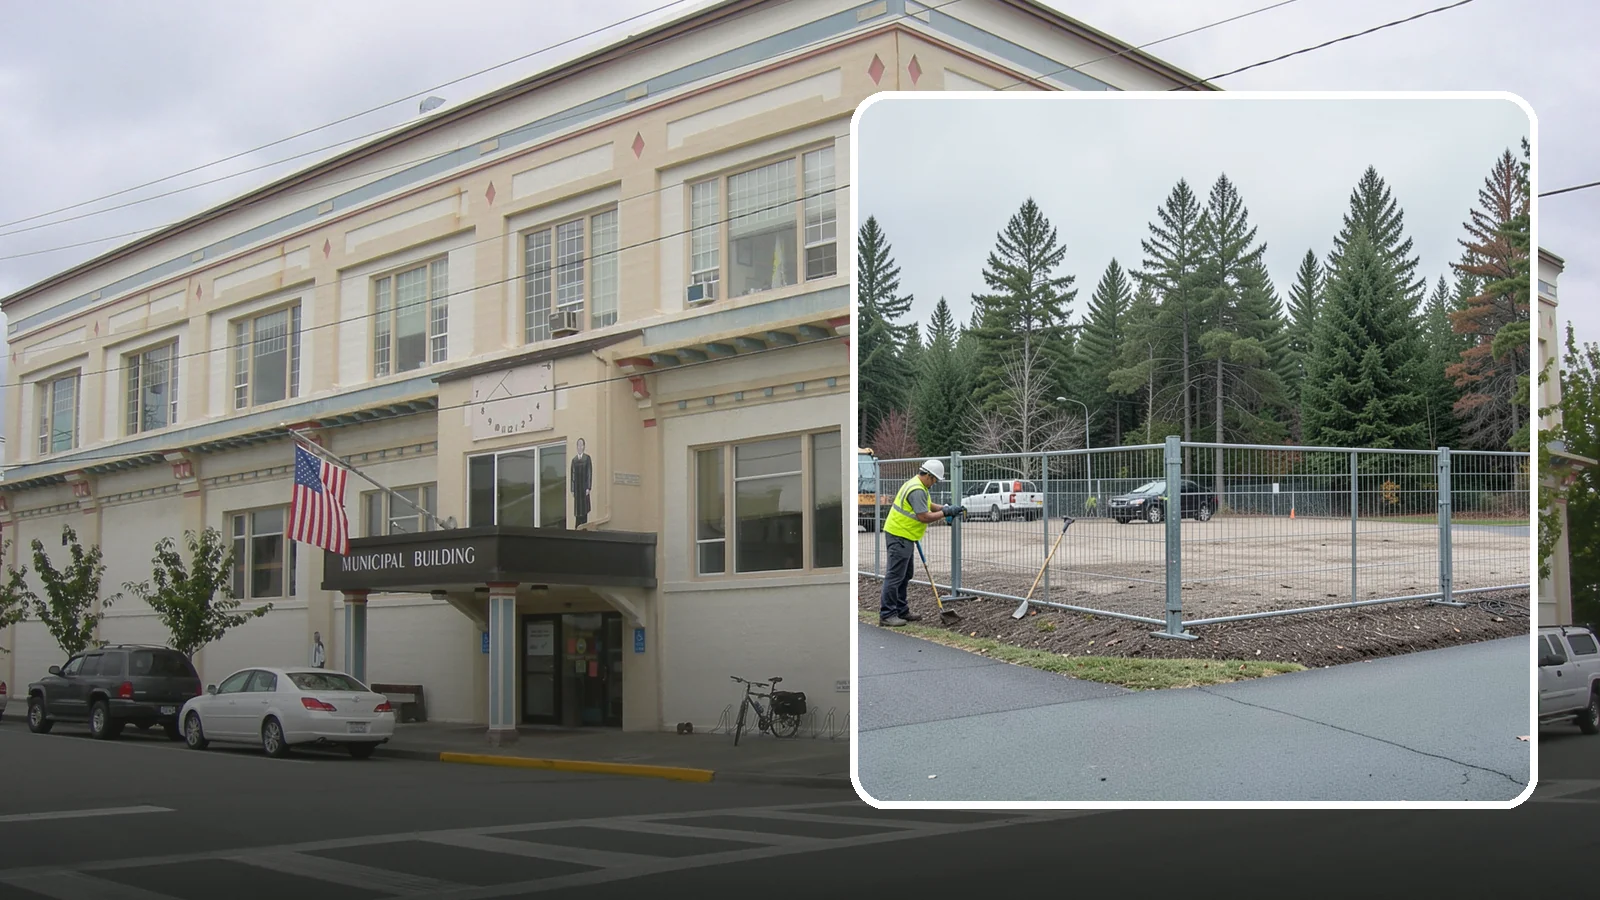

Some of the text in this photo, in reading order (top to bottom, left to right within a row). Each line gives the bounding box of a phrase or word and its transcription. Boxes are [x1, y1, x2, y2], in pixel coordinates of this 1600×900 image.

[546, 362, 552, 370] 6
[536, 402, 540, 410] 4
[480, 406, 484, 415] 8
[529, 414, 532, 422] 3
[342, 546, 475, 572] MUNICIPAL BUILDING
